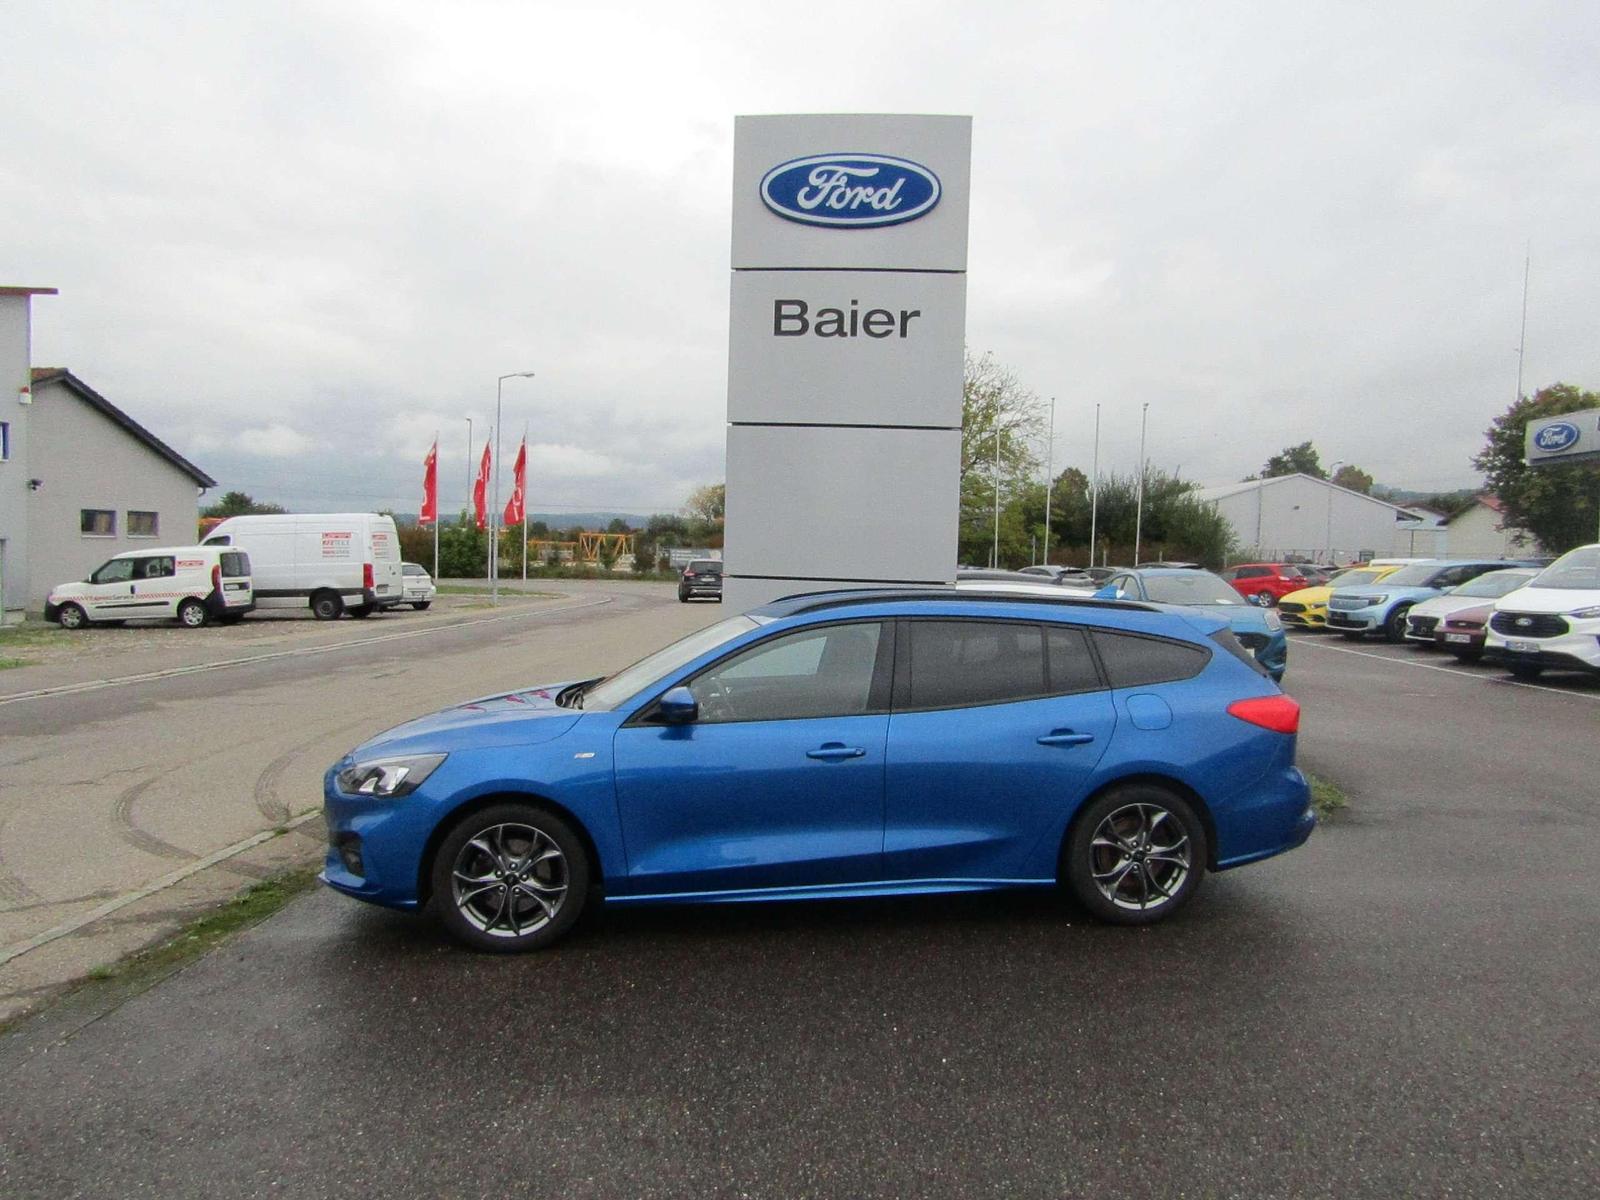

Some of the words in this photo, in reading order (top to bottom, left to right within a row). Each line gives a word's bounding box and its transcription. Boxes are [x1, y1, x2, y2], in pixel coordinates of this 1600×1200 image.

[796, 165, 906, 210] Ford
[773, 299, 921, 338] Baier
[1540, 427, 1569, 446] Ford
